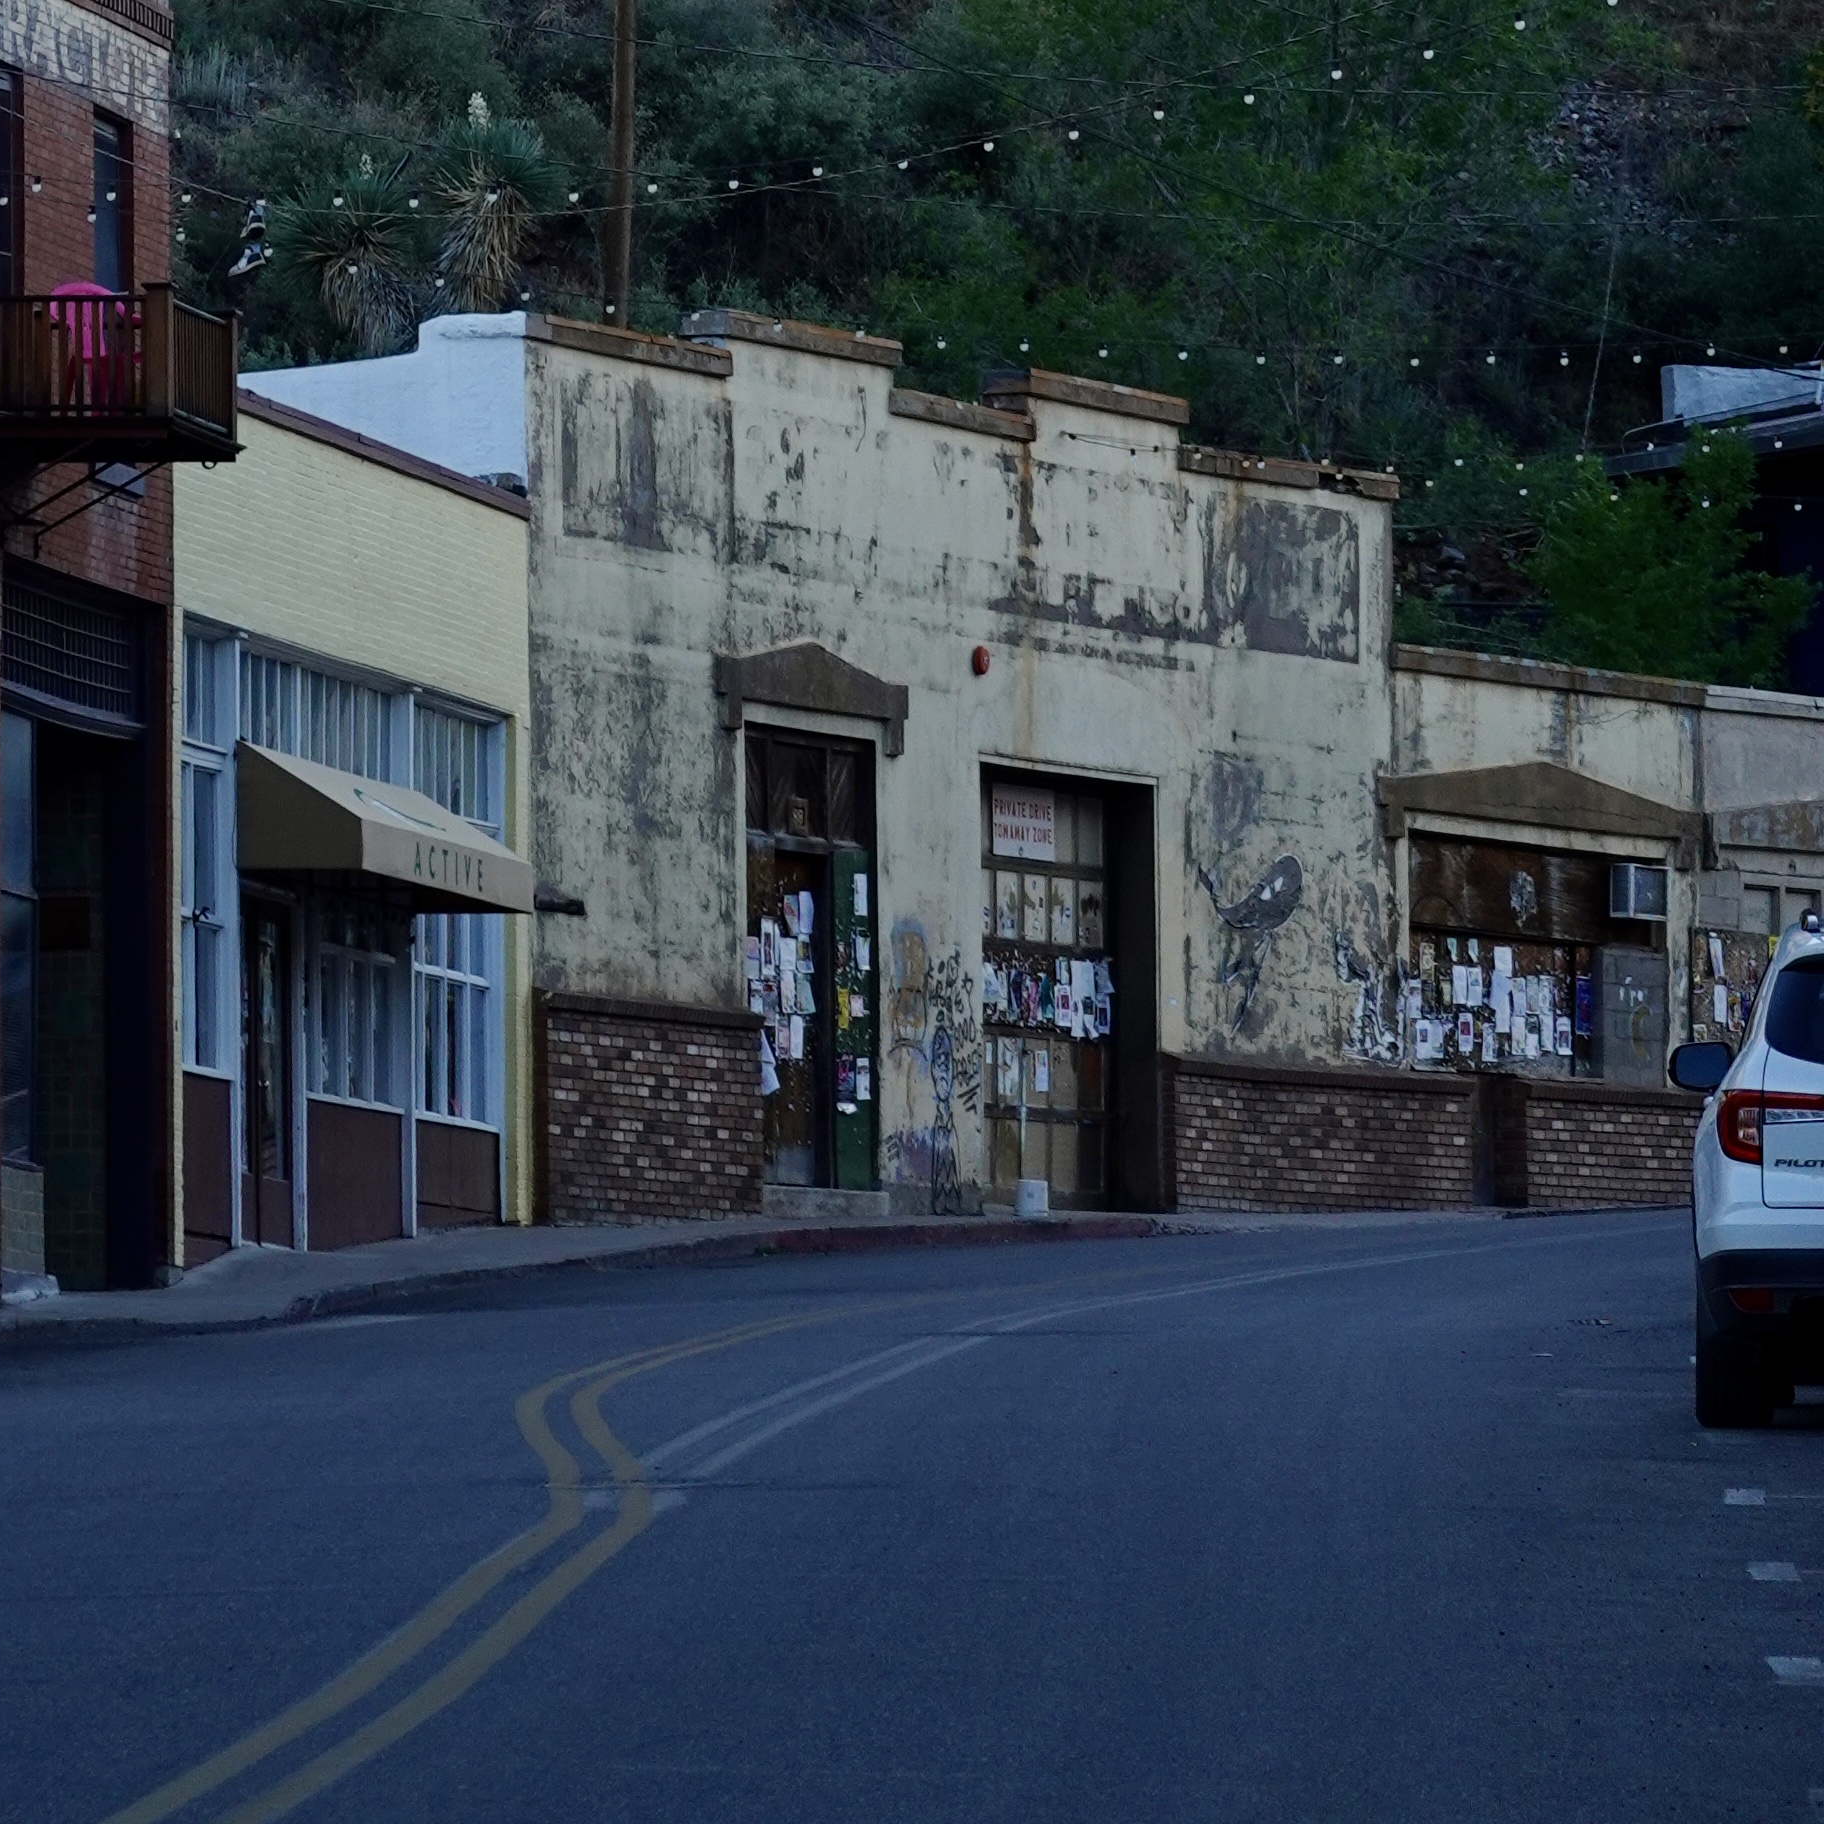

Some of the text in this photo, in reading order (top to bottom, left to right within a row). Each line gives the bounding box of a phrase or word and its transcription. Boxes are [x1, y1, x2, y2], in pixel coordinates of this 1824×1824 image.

[994, 799, 1052, 821] PRIVATE DRIVE
[1033, 827, 1052, 844] ZONE
[414, 842, 483, 892] ACTIVE
